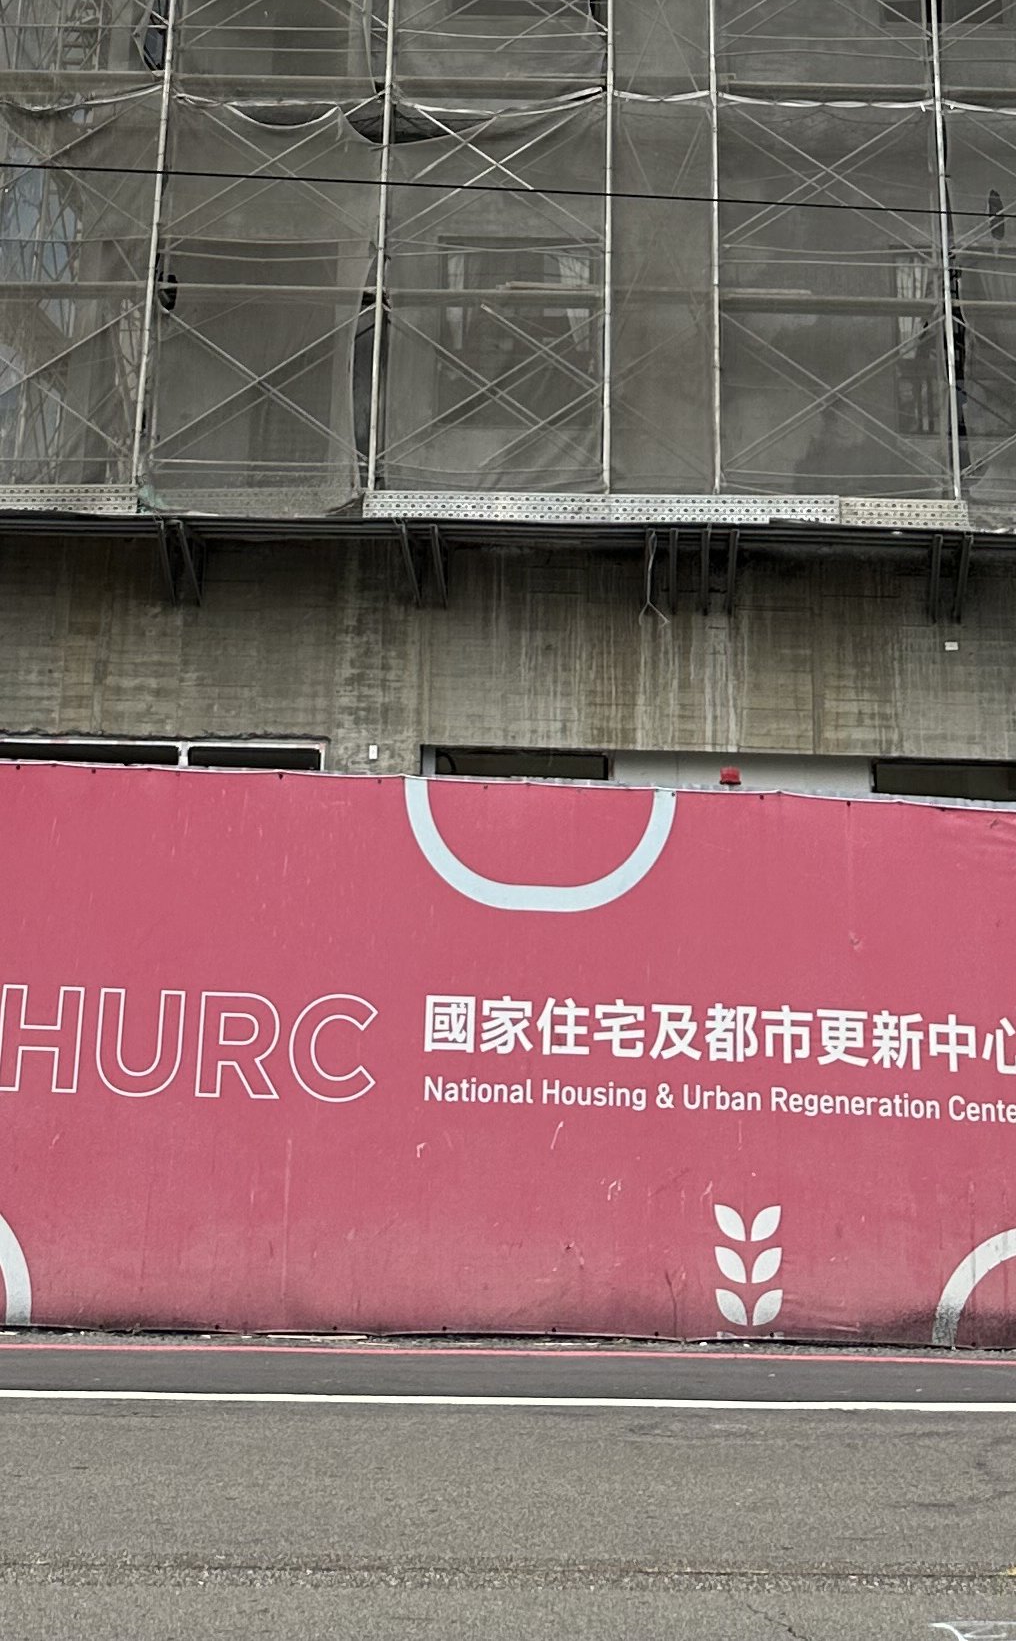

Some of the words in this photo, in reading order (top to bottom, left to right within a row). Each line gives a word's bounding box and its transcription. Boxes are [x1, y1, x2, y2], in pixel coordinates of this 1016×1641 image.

[0, 983, 379, 1103] HURC
[423, 1075, 533, 1104] National
[542, 1079, 647, 1111] Housing
[655, 1082, 675, 1109] &
[683, 1084, 762, 1111] Urban
[770, 1086, 940, 1120] Regeneration
